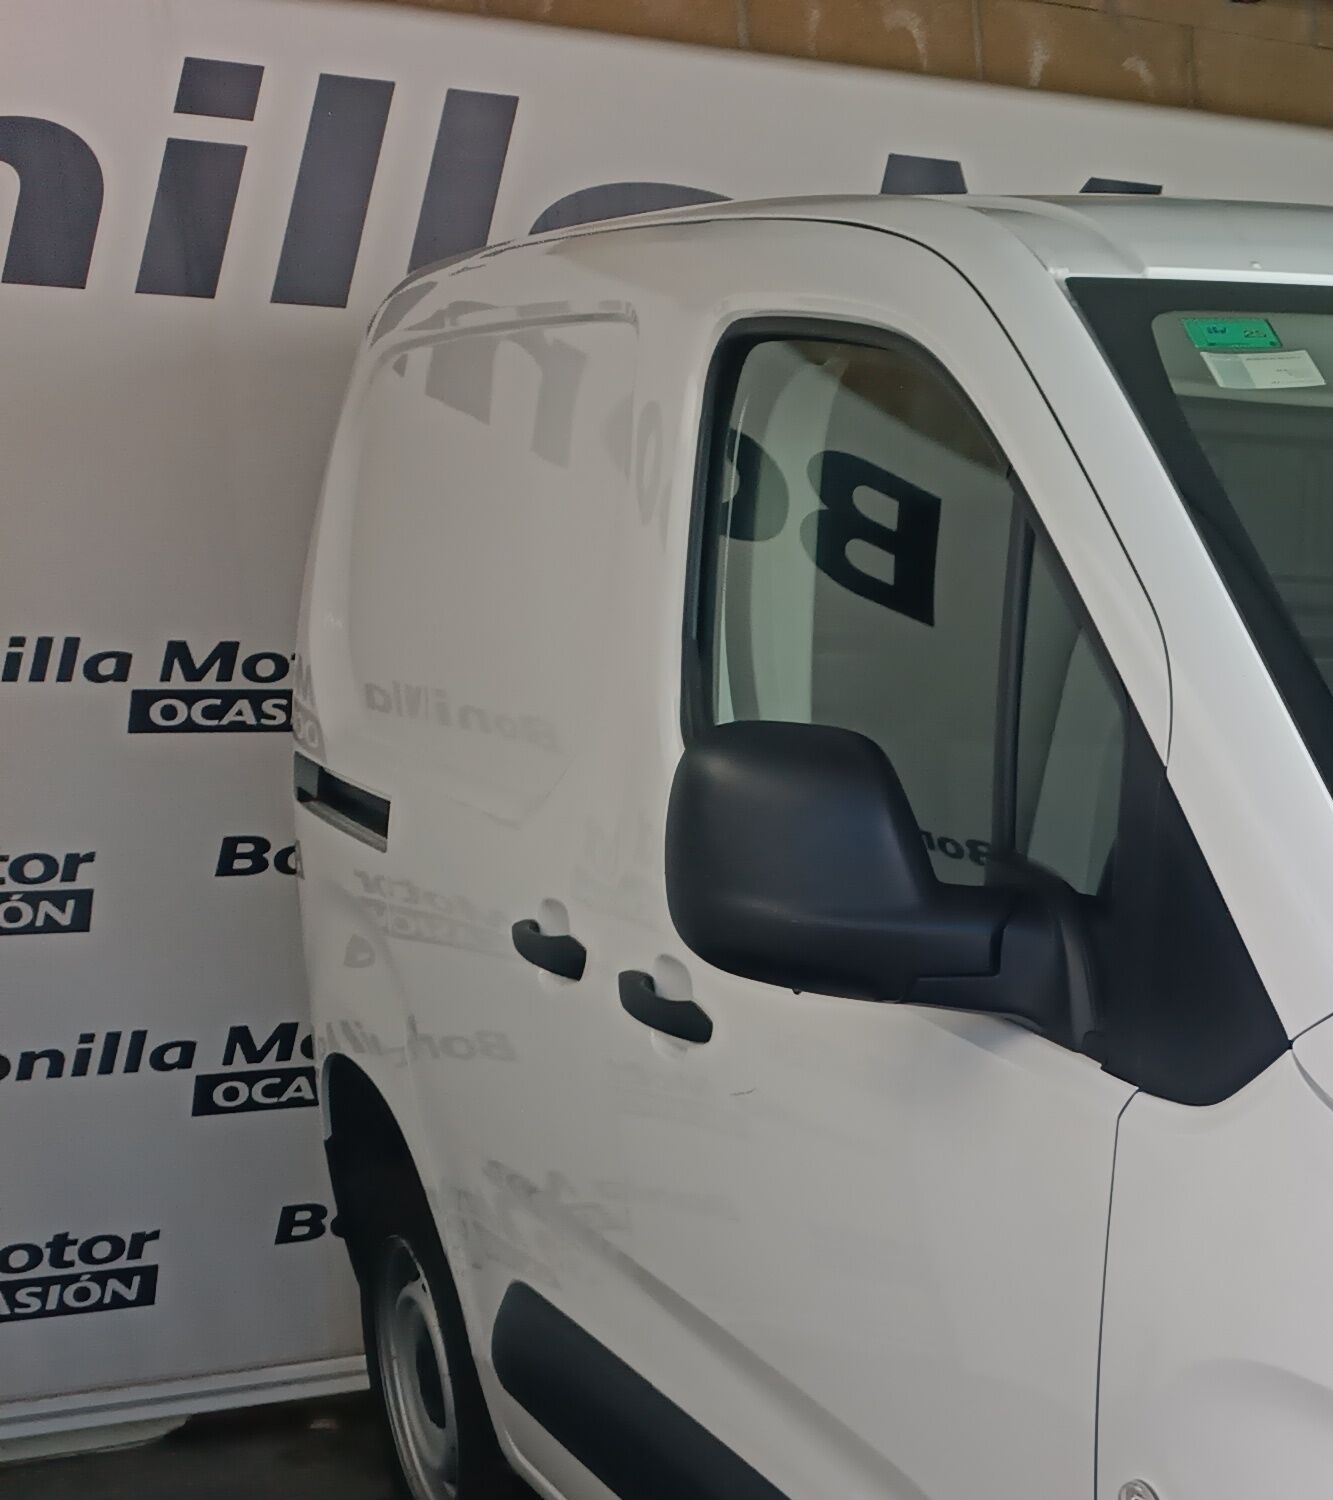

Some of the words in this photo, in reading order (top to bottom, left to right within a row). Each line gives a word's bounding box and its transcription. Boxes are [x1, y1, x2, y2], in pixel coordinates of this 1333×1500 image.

[160, 640, 296, 683] Mo
[0, 1030, 197, 1081] nilla
[212, 1075, 315, 1107] OCA
